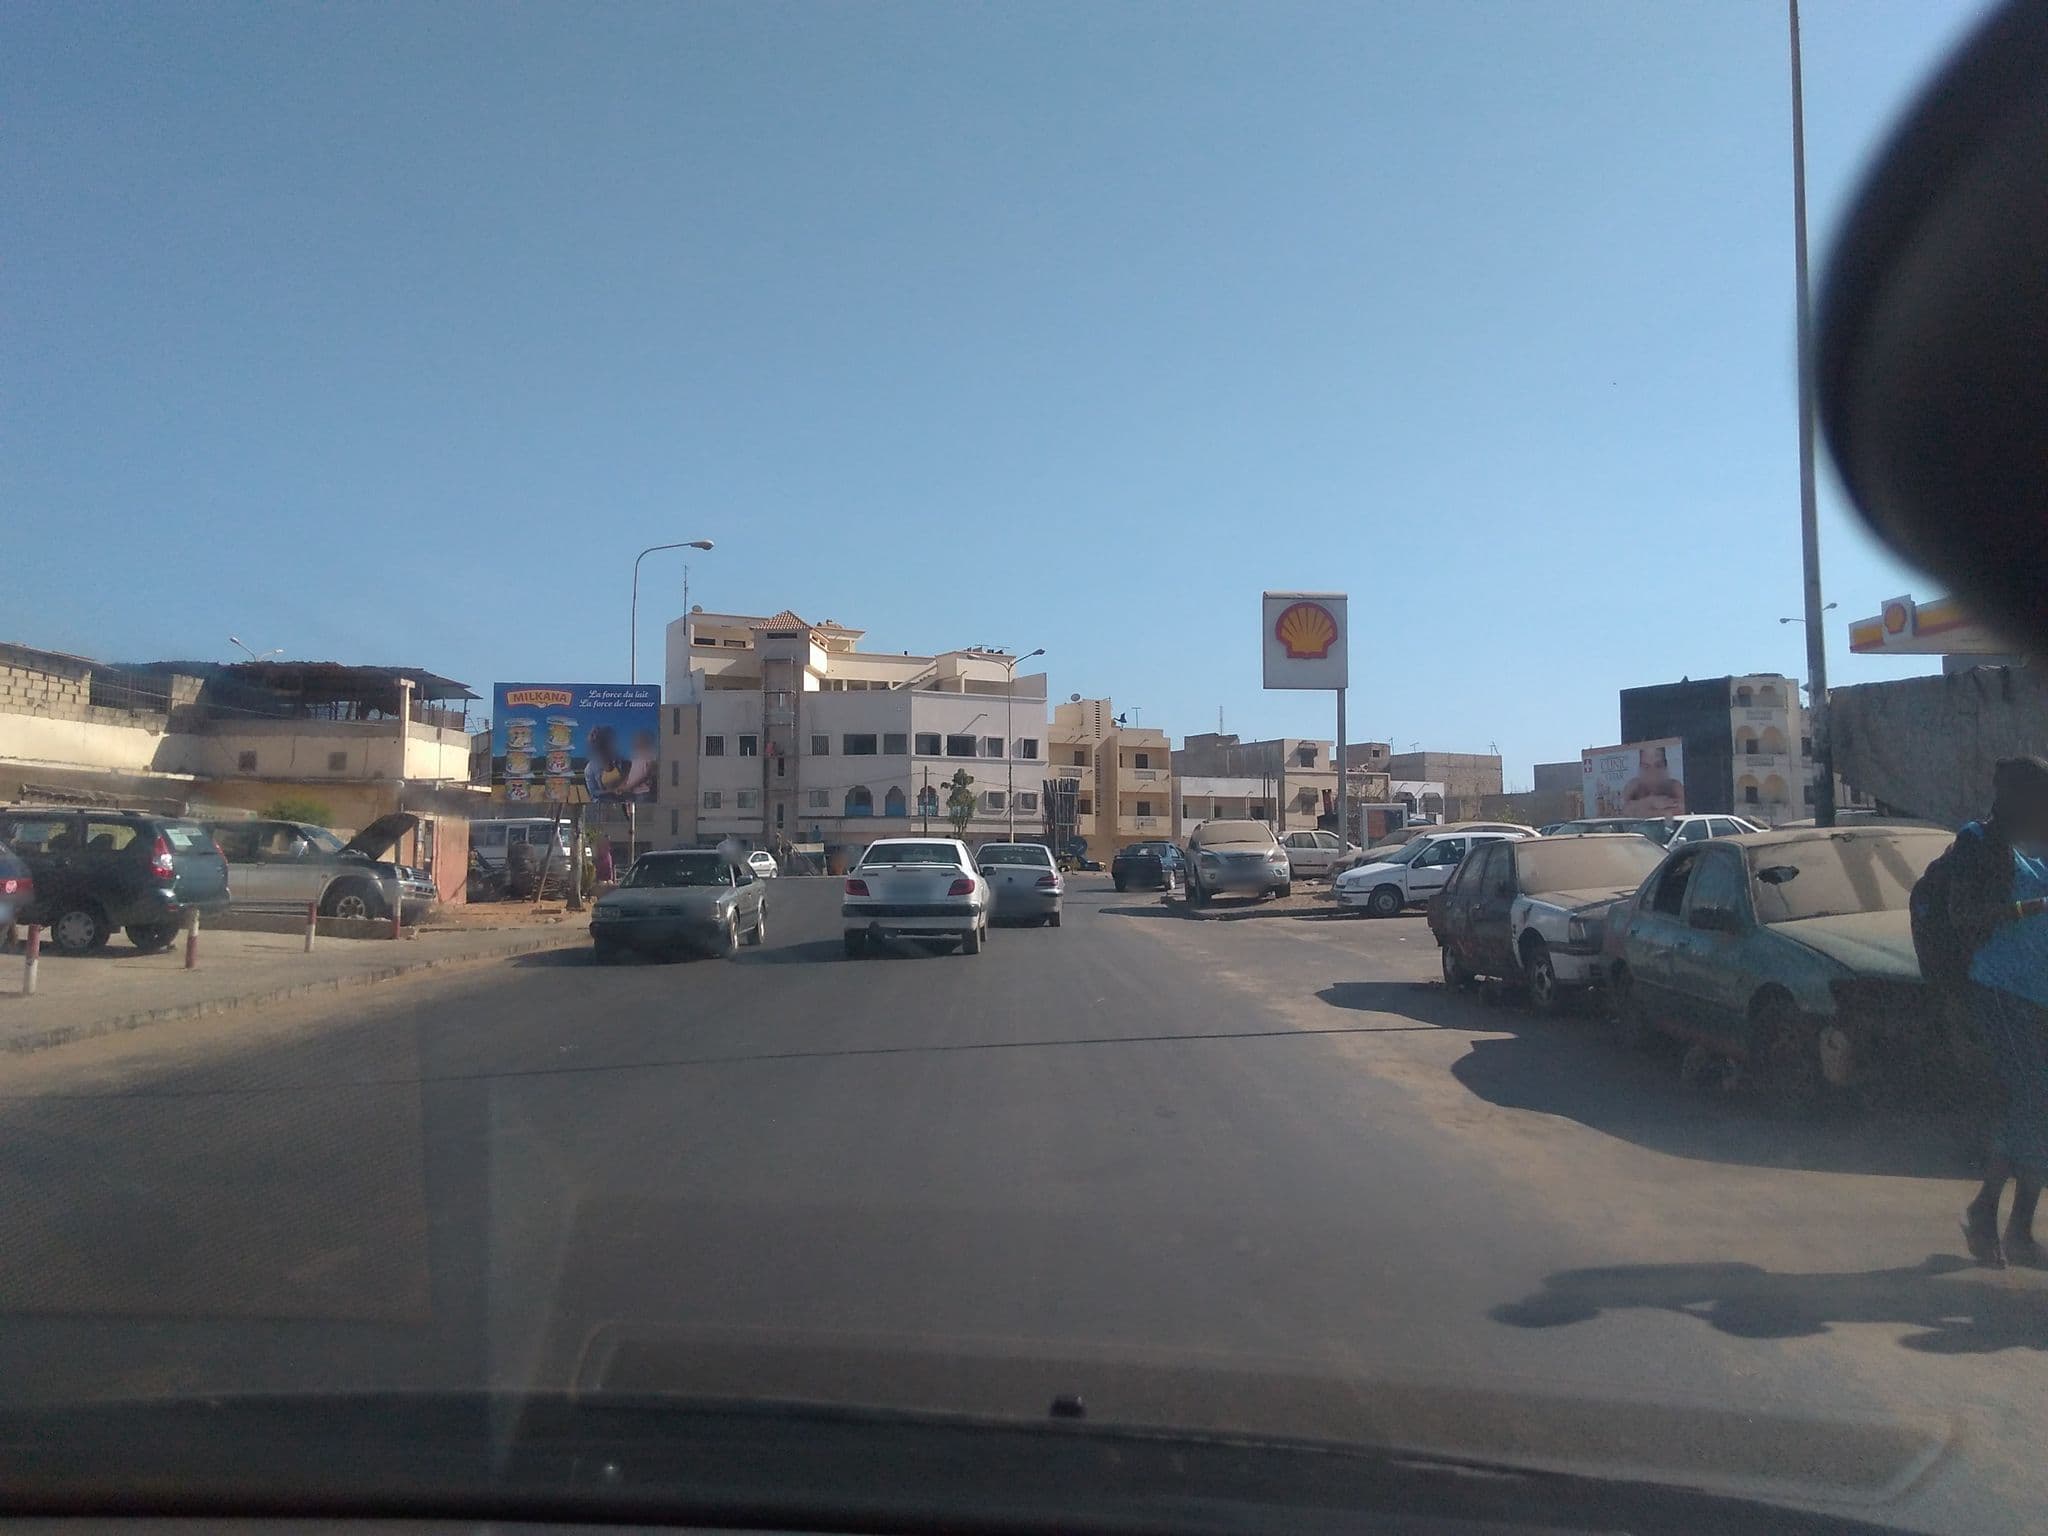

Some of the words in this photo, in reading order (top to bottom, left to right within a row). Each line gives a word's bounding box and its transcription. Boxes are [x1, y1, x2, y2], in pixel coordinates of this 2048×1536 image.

[512, 690, 568, 704] MILKANA
[588, 689, 602, 699] La
[602, 690, 622, 700] force
[623, 690, 634, 699] du
[635, 690, 649, 699] lait
[579, 698, 592, 708] La
[592, 699, 613, 709] force
[613, 699, 624, 708] de
[625, 699, 656, 708] l'amour
